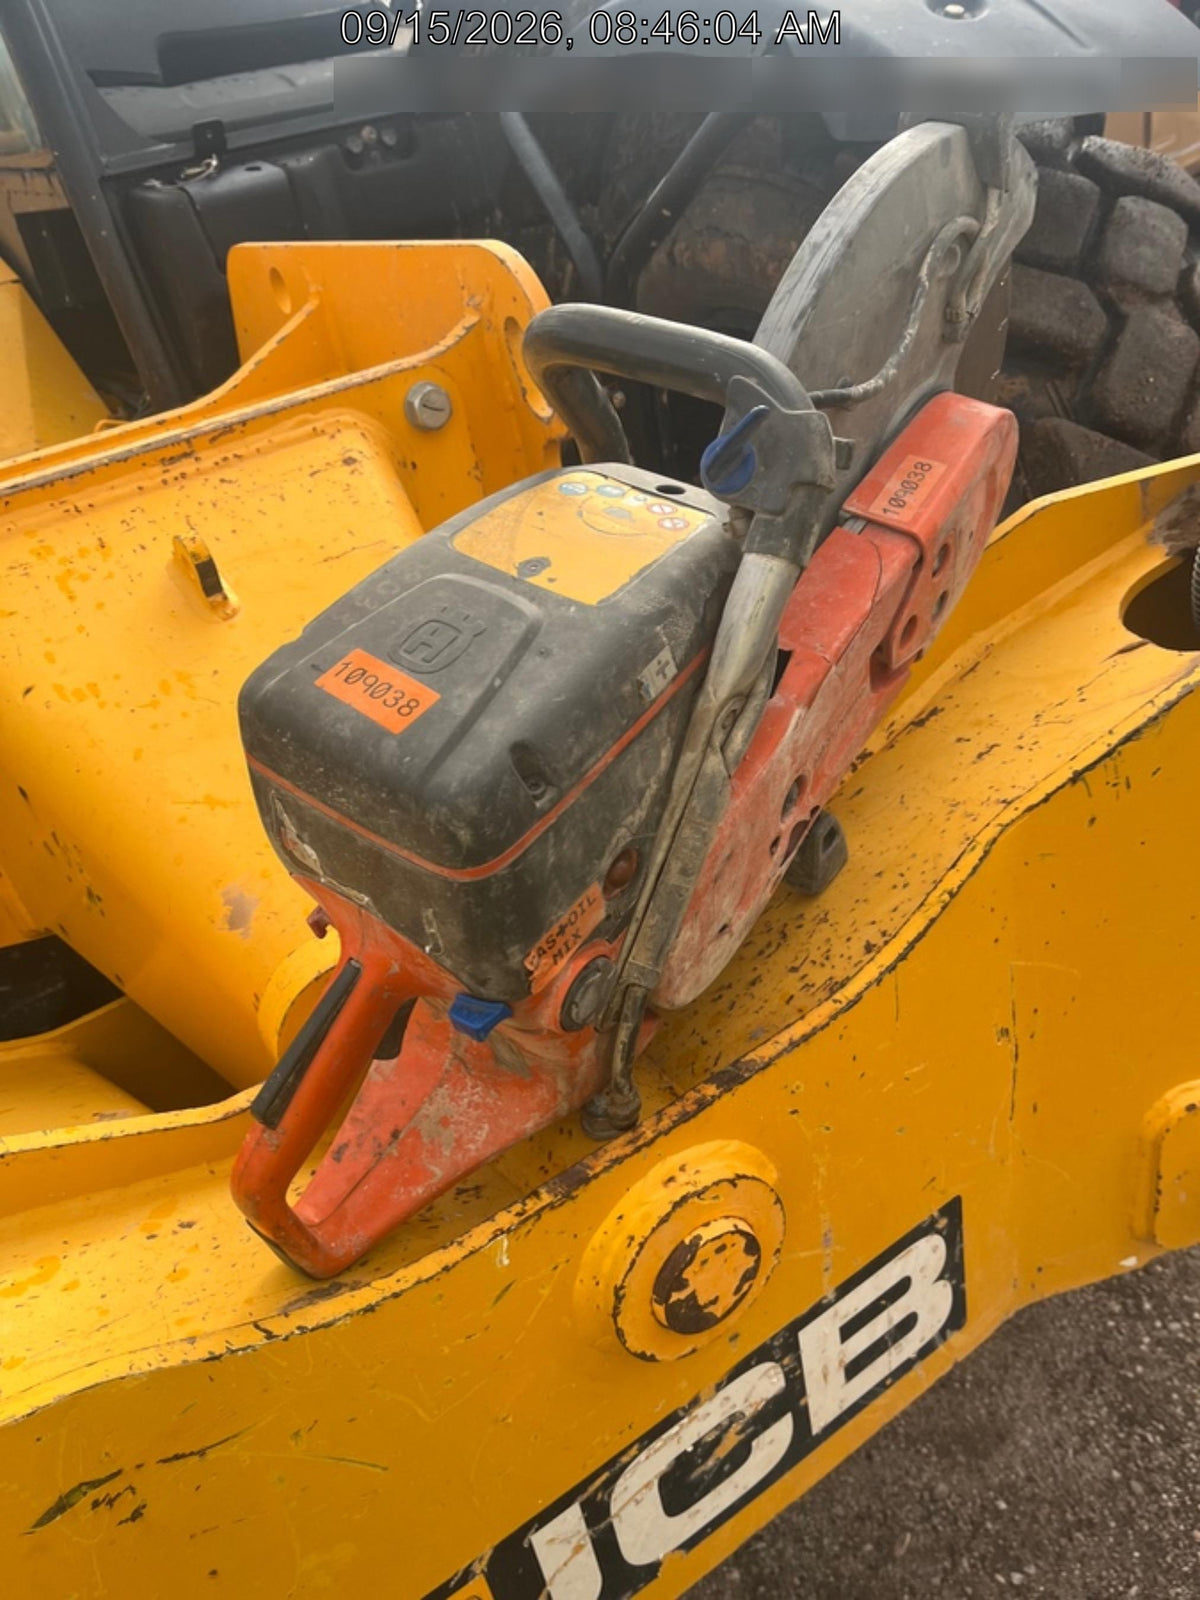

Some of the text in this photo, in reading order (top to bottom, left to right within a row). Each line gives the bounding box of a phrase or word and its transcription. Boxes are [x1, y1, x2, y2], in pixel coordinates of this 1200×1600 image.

[882, 461, 932, 515] 109038
[334, 660, 420, 717] 109038
[552, 928, 582, 966] MIX
[528, 1233, 953, 1600] JCB
